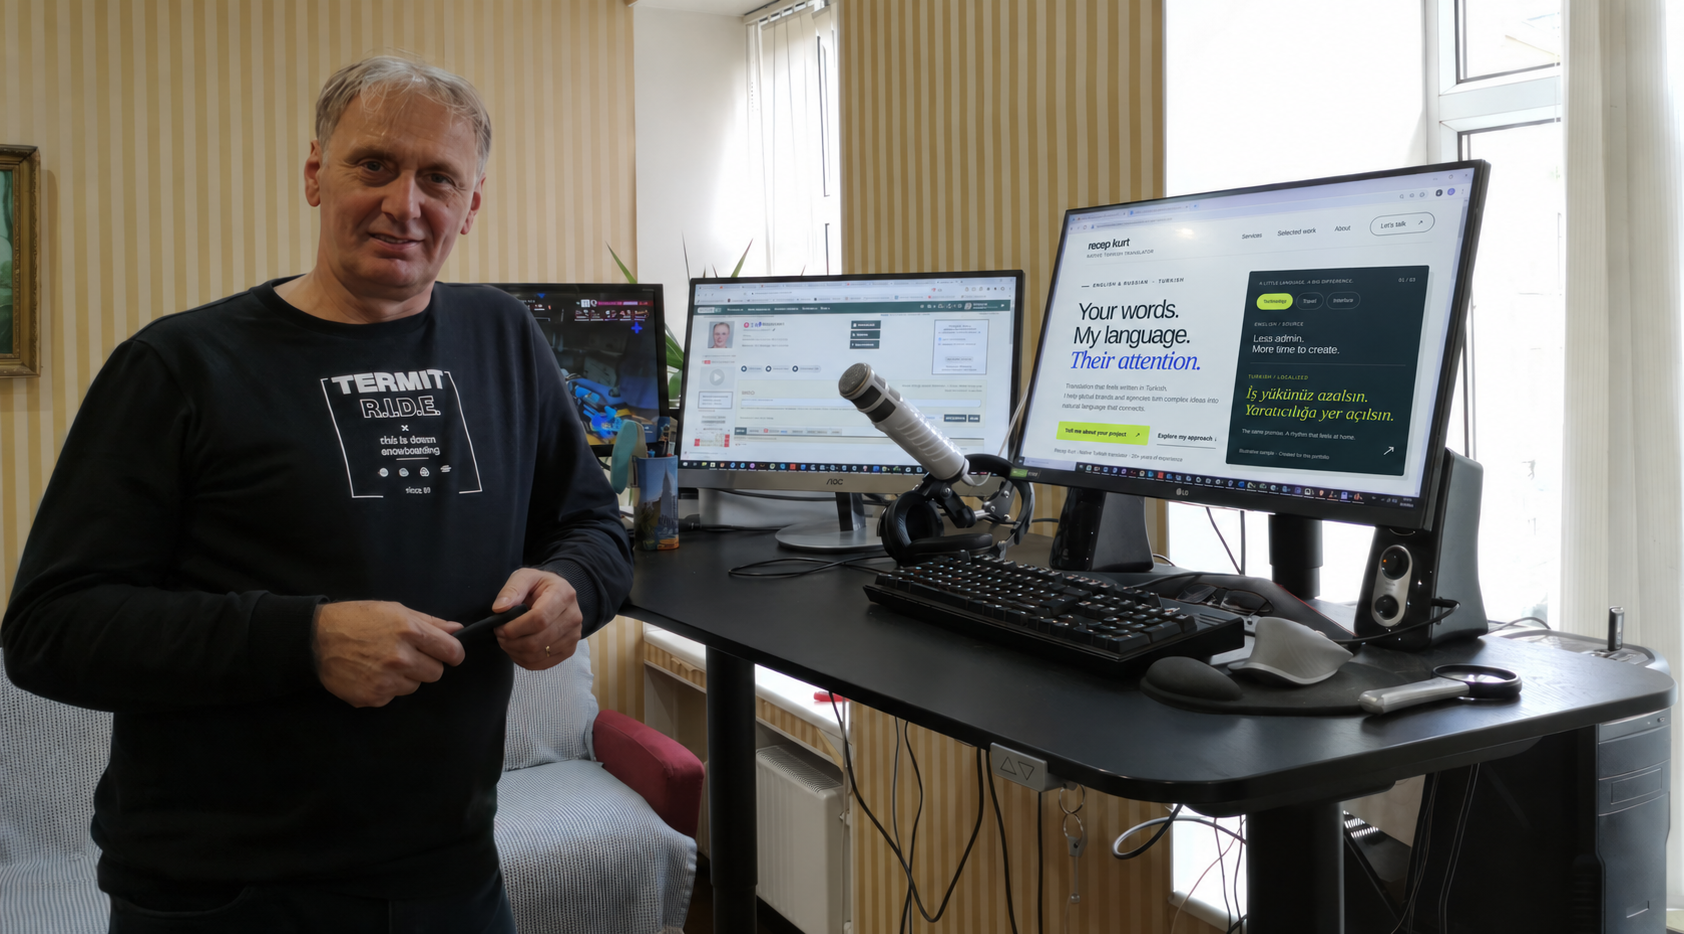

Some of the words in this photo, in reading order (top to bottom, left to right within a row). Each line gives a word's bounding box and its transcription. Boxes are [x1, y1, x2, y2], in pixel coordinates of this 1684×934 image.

[1277, 229, 1301, 237] Selected
[1088, 241, 1110, 250] recep
[1112, 238, 1130, 248] kurt
[1079, 302, 1118, 321] Your
[1121, 299, 1179, 320] words.
[1073, 326, 1101, 349] My
[1104, 325, 1191, 349] language.
[1253, 334, 1273, 343] Less
[1274, 334, 1304, 343] admin.
[1252, 345, 1274, 354] More
[1276, 345, 1296, 354] time
[1297, 345, 1307, 354] to
[1308, 346, 1340, 355] create.
[1070, 350, 1116, 370] Their
[1118, 351, 1201, 371] attention.
[331, 369, 444, 395] TERMIT
[1246, 385, 1258, 402] İş
[1258, 388, 1314, 403] yükünüz
[1317, 389, 1368, 403] azalsın.
[360, 395, 441, 419] R.I.D.E.
[1245, 404, 1317, 421] Yaratıcılığa
[1319, 409, 1343, 422] yer
[1346, 408, 1394, 423] açılsın.
[826, 478, 844, 486] AOC
